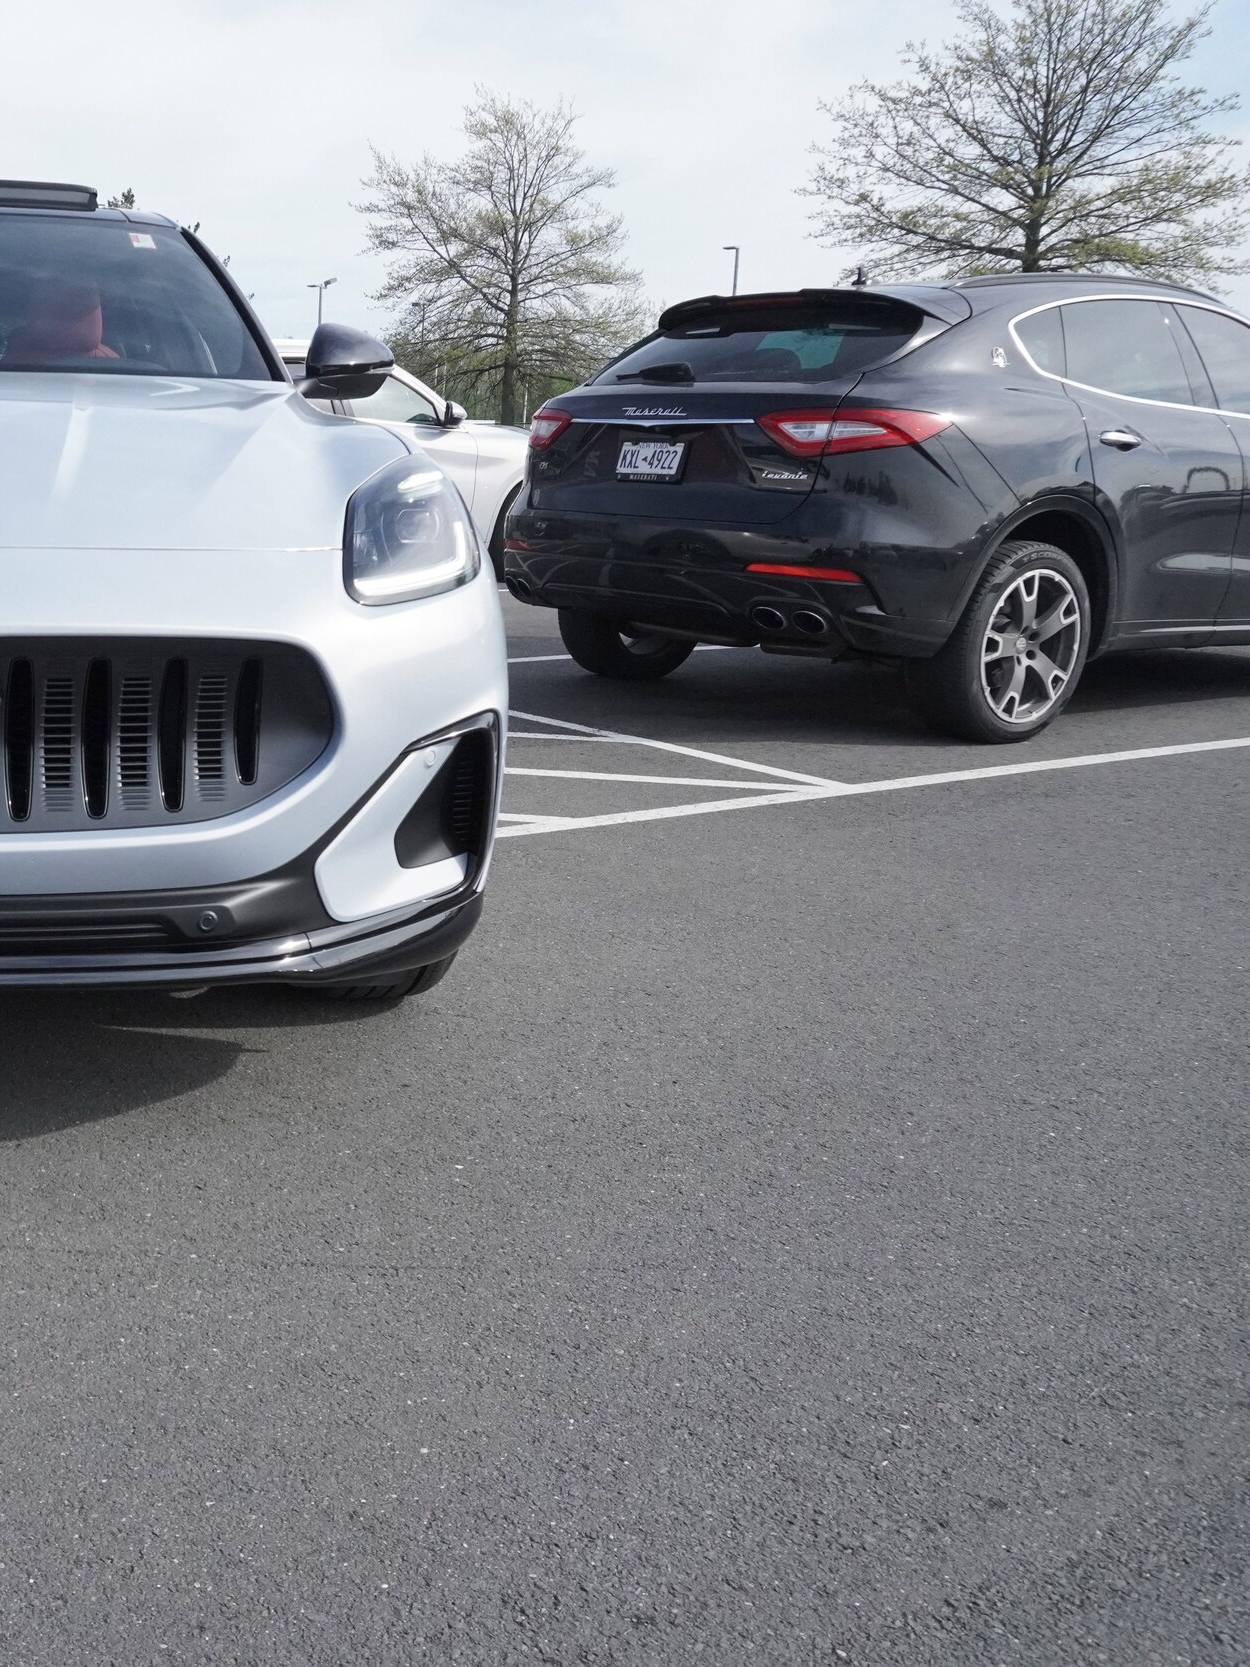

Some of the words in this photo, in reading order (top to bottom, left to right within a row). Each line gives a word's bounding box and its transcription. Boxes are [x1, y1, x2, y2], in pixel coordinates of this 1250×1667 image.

[622, 406, 687, 416] Maserati
[620, 449, 640, 469] KXL
[648, 450, 678, 469] 4922
